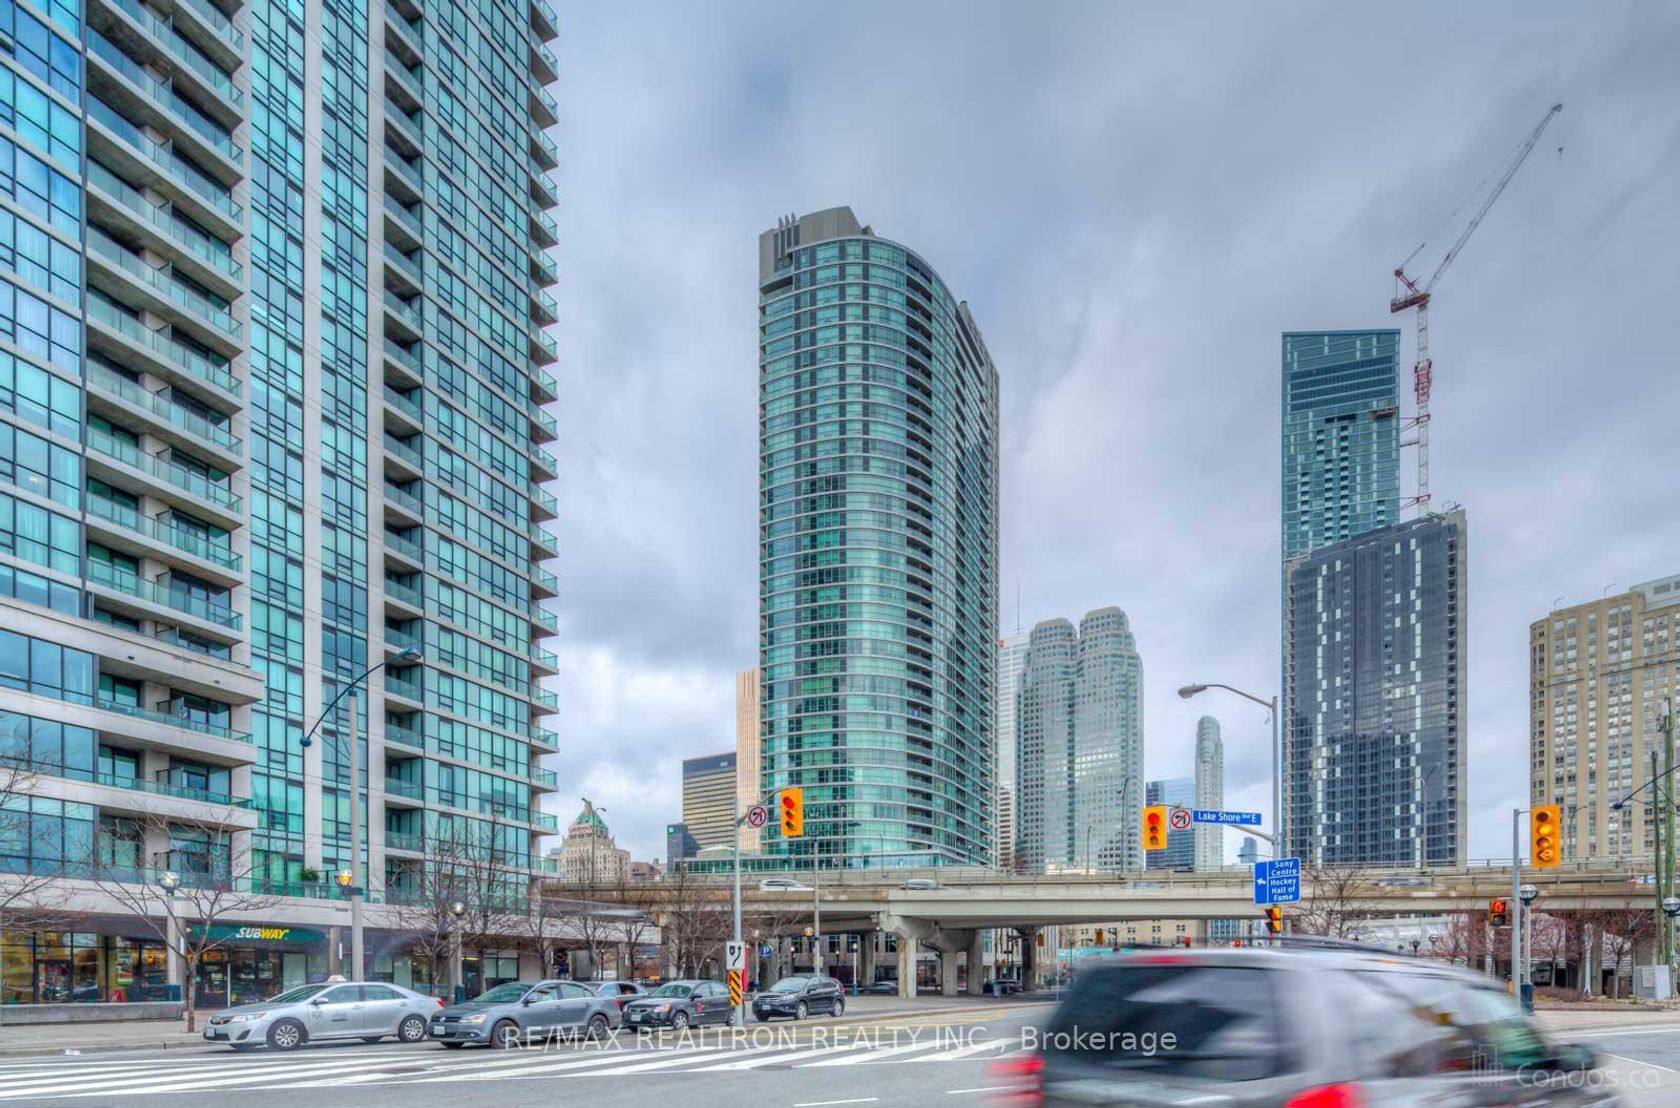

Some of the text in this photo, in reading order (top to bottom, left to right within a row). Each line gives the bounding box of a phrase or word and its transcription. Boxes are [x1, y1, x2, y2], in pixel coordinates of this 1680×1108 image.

[1198, 811, 1217, 821] Lake
[1218, 812, 1241, 823] Shore
[1251, 813, 1257, 823] E
[1274, 860, 1294, 869] Sony
[1271, 868, 1297, 876] Centre
[1270, 878, 1297, 887] Hockey
[1271, 886, 1287, 895] Hall
[1273, 894, 1294, 902] Fame
[235, 926, 290, 939] SUBWAY
